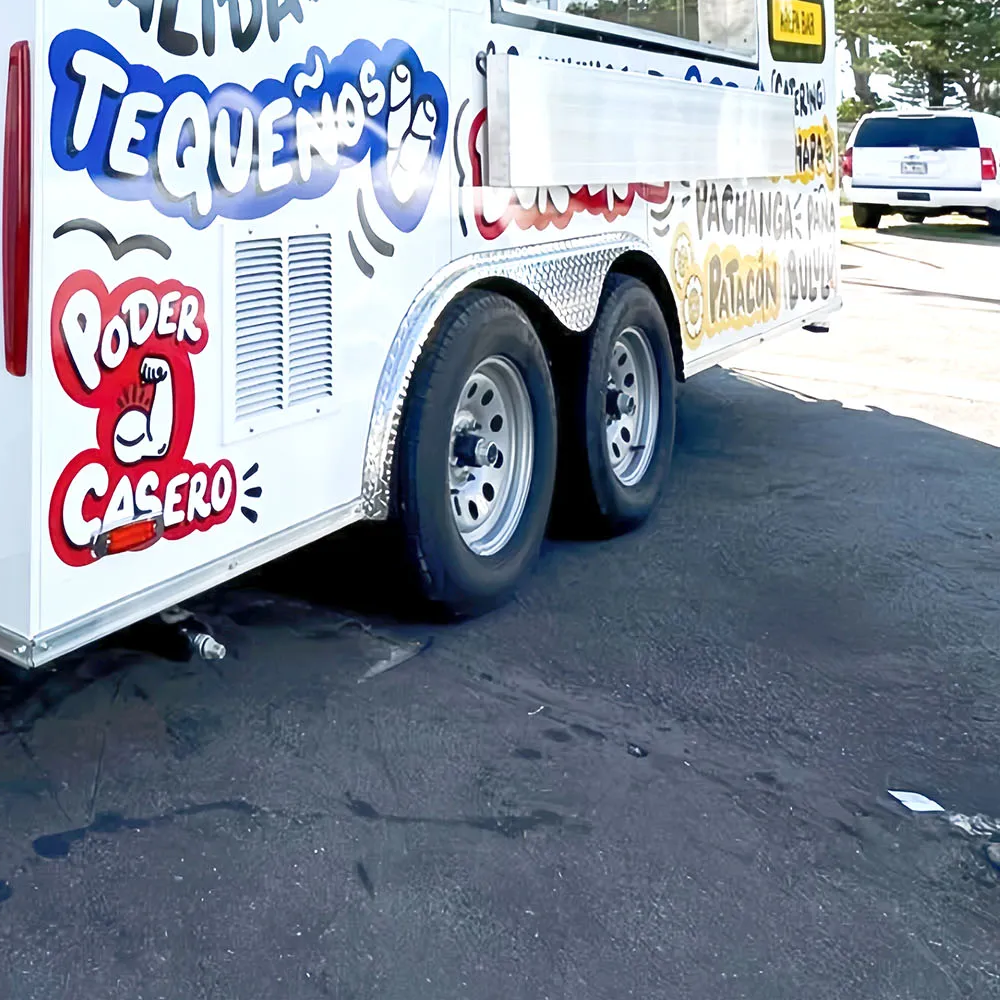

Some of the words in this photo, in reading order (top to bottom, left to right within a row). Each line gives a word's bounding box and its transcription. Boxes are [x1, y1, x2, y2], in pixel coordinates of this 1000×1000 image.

[69, 48, 386, 215] TEQUEÑOS
[696, 180, 793, 240] PACHANGA
[61, 289, 202, 390] PODER
[62, 462, 233, 547] CASERO
